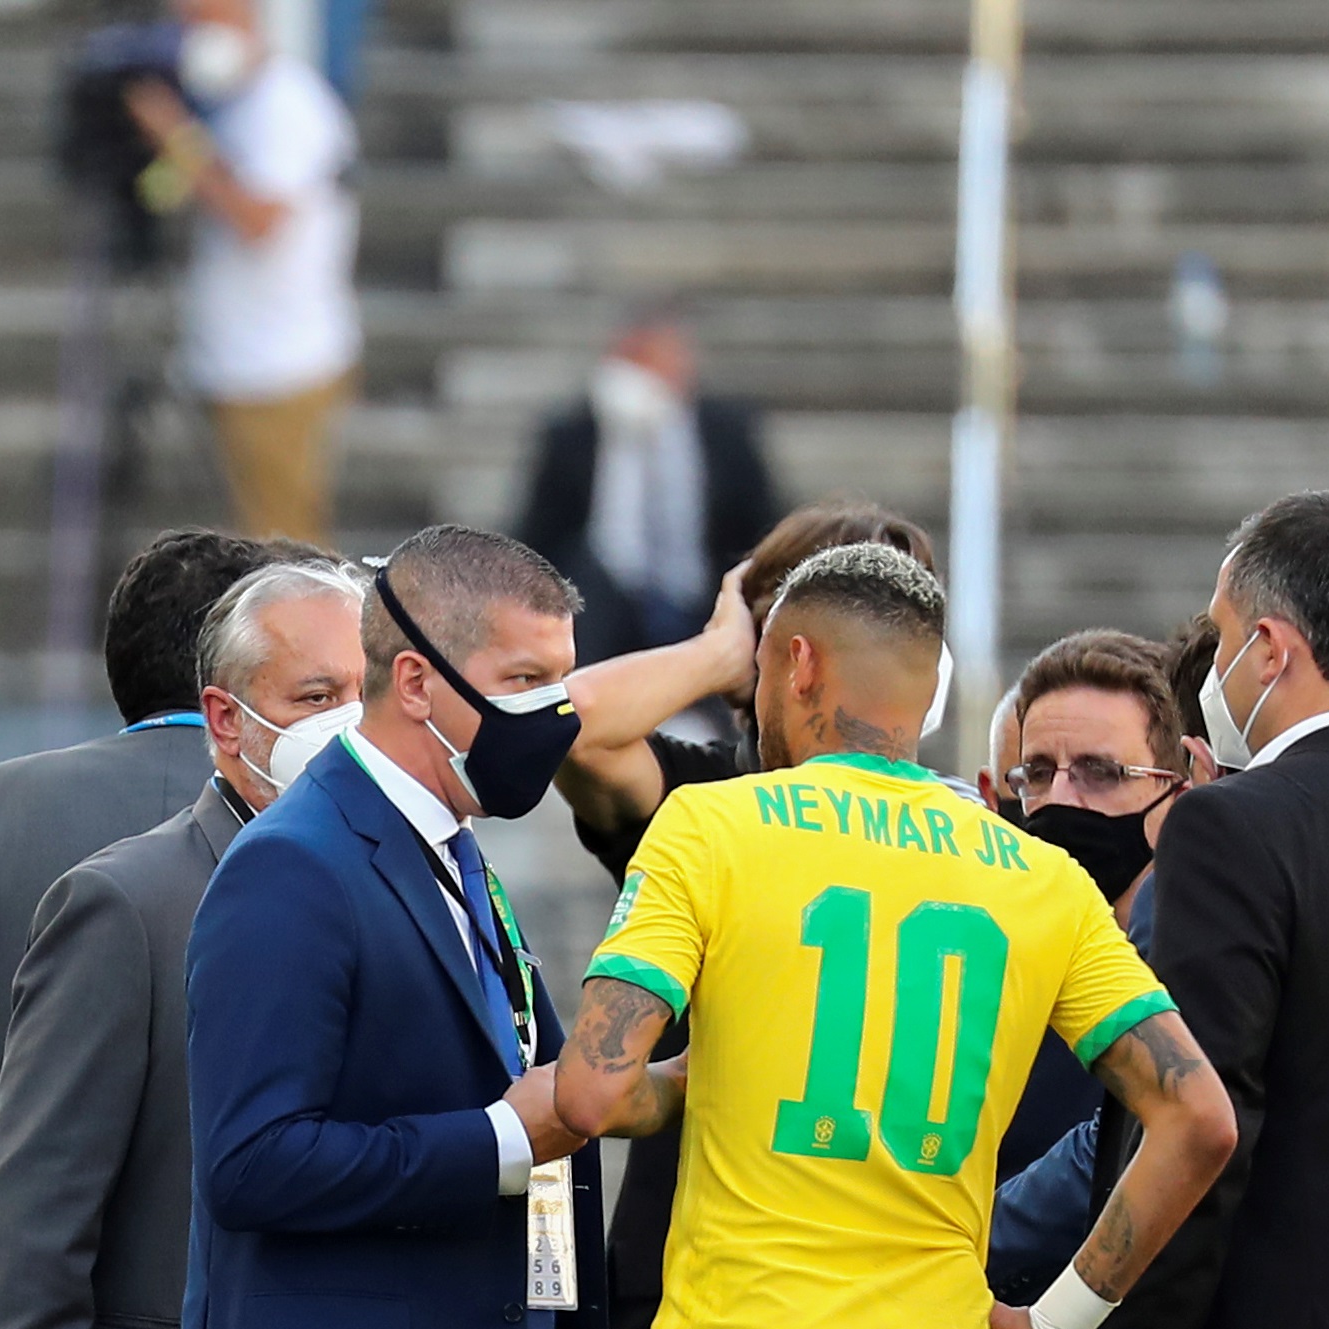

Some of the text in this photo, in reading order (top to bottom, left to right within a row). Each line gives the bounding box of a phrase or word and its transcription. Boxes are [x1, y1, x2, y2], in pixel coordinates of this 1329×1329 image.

[753, 783, 1031, 872] NEYMAR JR
[771, 883, 1010, 1177] 10
[534, 1260, 560, 1274] 5 6
[535, 1281, 561, 1295] 8 9
